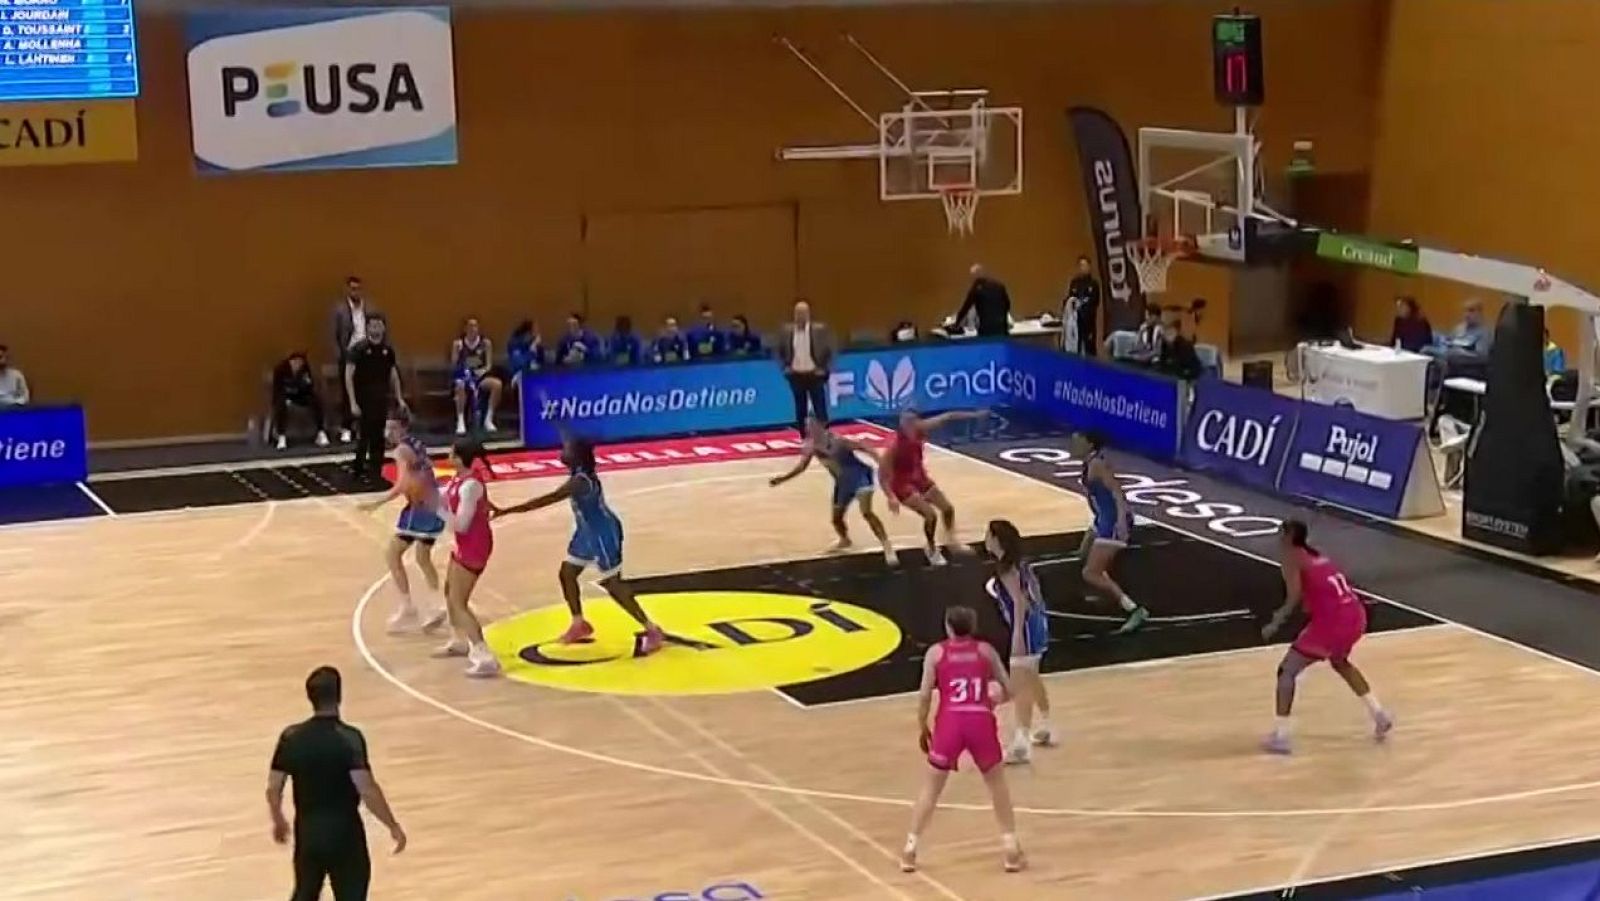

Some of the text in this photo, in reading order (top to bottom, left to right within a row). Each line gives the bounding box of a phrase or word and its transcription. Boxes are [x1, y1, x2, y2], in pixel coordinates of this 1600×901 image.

[222, 61, 424, 117] PEUSA
[541, 385, 757, 420] #NadaNosDetiene
[818, 360, 1036, 407] F endesa
[1053, 379, 1167, 429] #NadaNosDetiene
[1197, 413, 1283, 466] CADÍ
[1326, 425, 1378, 464] Pujol
[948, 678, 982, 702] 31
